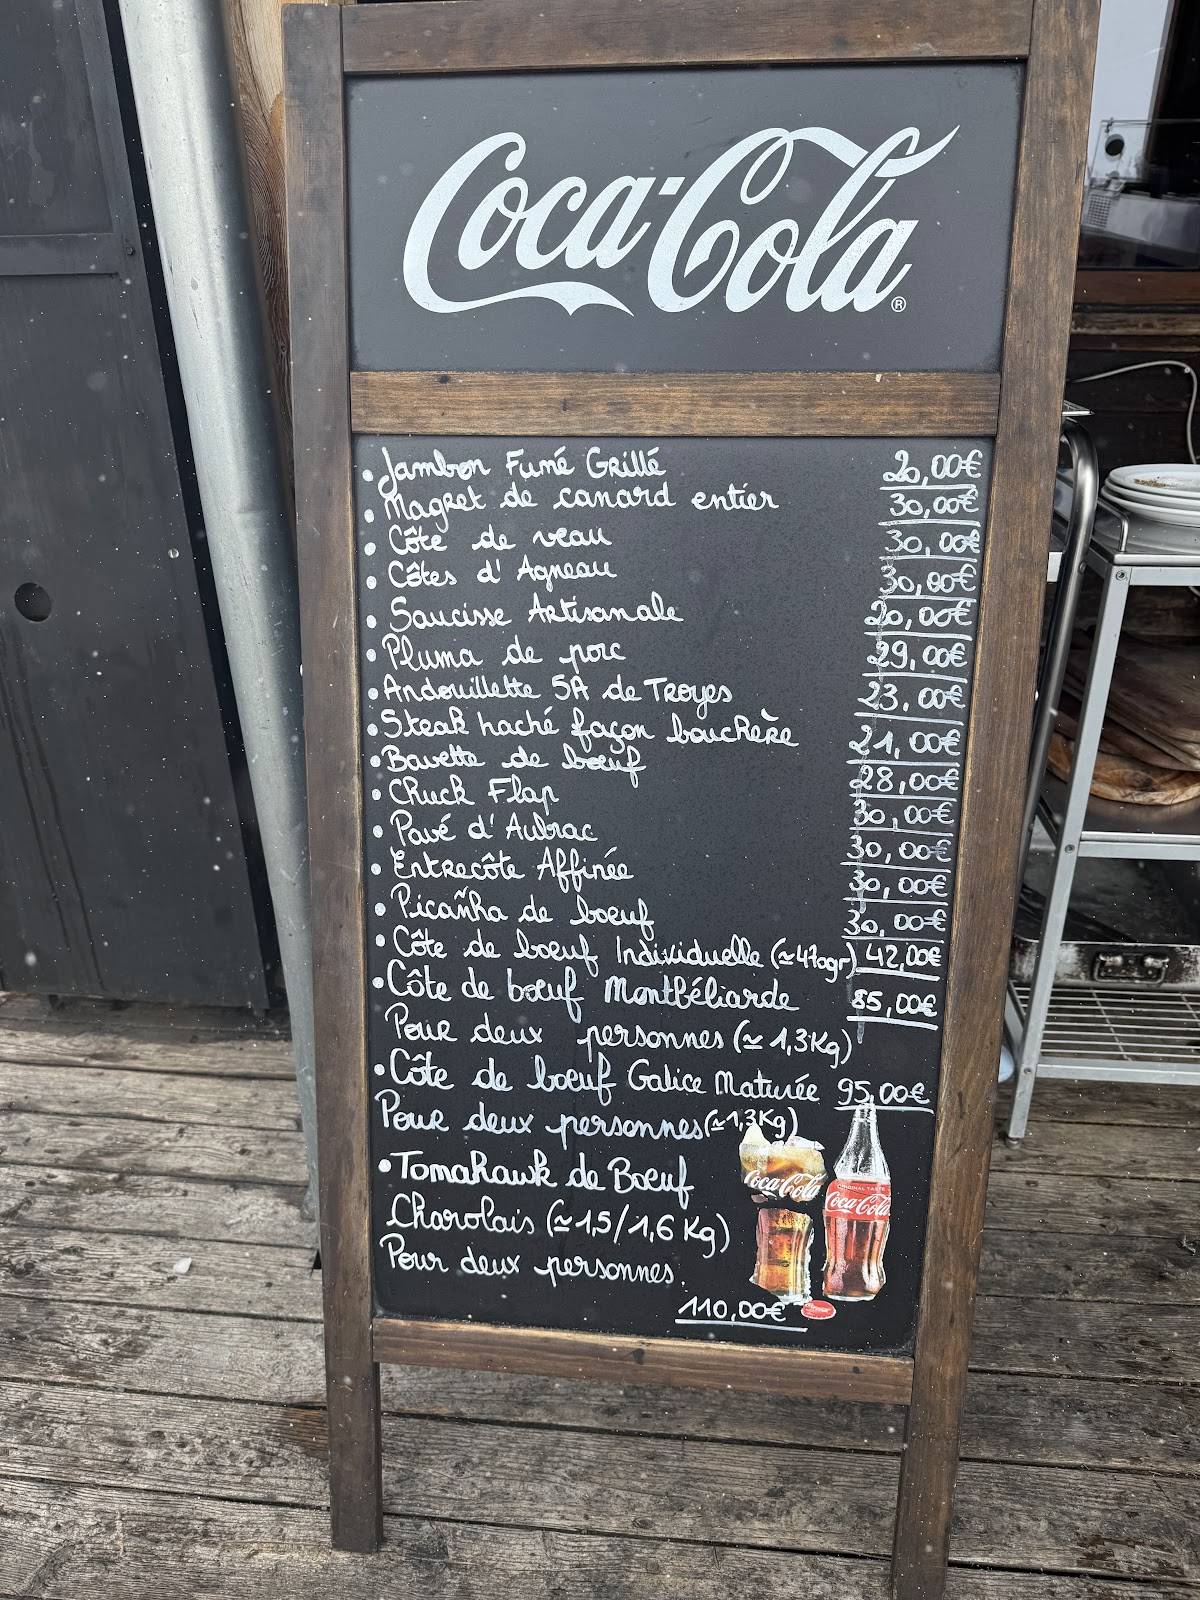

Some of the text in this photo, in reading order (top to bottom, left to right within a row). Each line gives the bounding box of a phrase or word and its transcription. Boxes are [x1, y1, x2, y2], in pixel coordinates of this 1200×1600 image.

[403, 124, 960, 316] Coca-Cola
[378, 447, 490, 498] Jambon
[505, 446, 574, 477] Fumé
[586, 446, 666, 479] Grillé
[385, 486, 486, 533] Magret
[500, 482, 538, 508] de
[553, 482, 676, 510] canard
[692, 482, 780, 510] entier
[388, 524, 448, 555] Côte
[472, 524, 516, 550] de
[533, 526, 613, 547] veau
[388, 560, 457, 588] Côtes
[390, 596, 511, 632] Saucisse
[528, 591, 685, 623] Artisanale
[381, 633, 484, 671] Pluma
[502, 635, 543, 665] de
[559, 642, 627, 674] porc
[383, 674, 542, 703] Andouillette
[552, 674, 590, 701] 5A
[601, 674, 643, 701] de
[643, 677, 733, 719] Troyes
[381, 706, 470, 738] Steak
[477, 706, 559, 737] haché
[570, 707, 655, 754] façon
[667, 709, 800, 747] bouchère
[381, 745, 486, 772] Bavette
[501, 746, 550, 768] de
[388, 774, 476, 806] Chuck
[488, 774, 560, 816] Flap
[389, 809, 457, 846] Pavé
[390, 847, 526, 880] Entrecôte
[536, 846, 635, 893] Affinée
[518, 894, 554, 923] de
[393, 925, 448, 958] Côte
[463, 928, 501, 958] de
[616, 934, 764, 967] Individuelle
[386, 959, 453, 1001] Côte
[461, 967, 495, 1001] de
[604, 975, 800, 1011] Montbéliarde
[384, 1002, 458, 1040] Pour
[470, 1012, 543, 1045] deux
[576, 1024, 725, 1063] personnes
[389, 1048, 455, 1090] Côte
[471, 1057, 514, 1092] de
[627, 1058, 706, 1094] Galice
[374, 1088, 450, 1132] Pour
[462, 1101, 535, 1135] deux
[545, 1113, 704, 1151] personnes
[390, 1149, 558, 1188] Tomahawk
[565, 1152, 607, 1190] de
[385, 1191, 536, 1236] Charolais
[379, 1232, 675, 1288] Pour deux personnes
